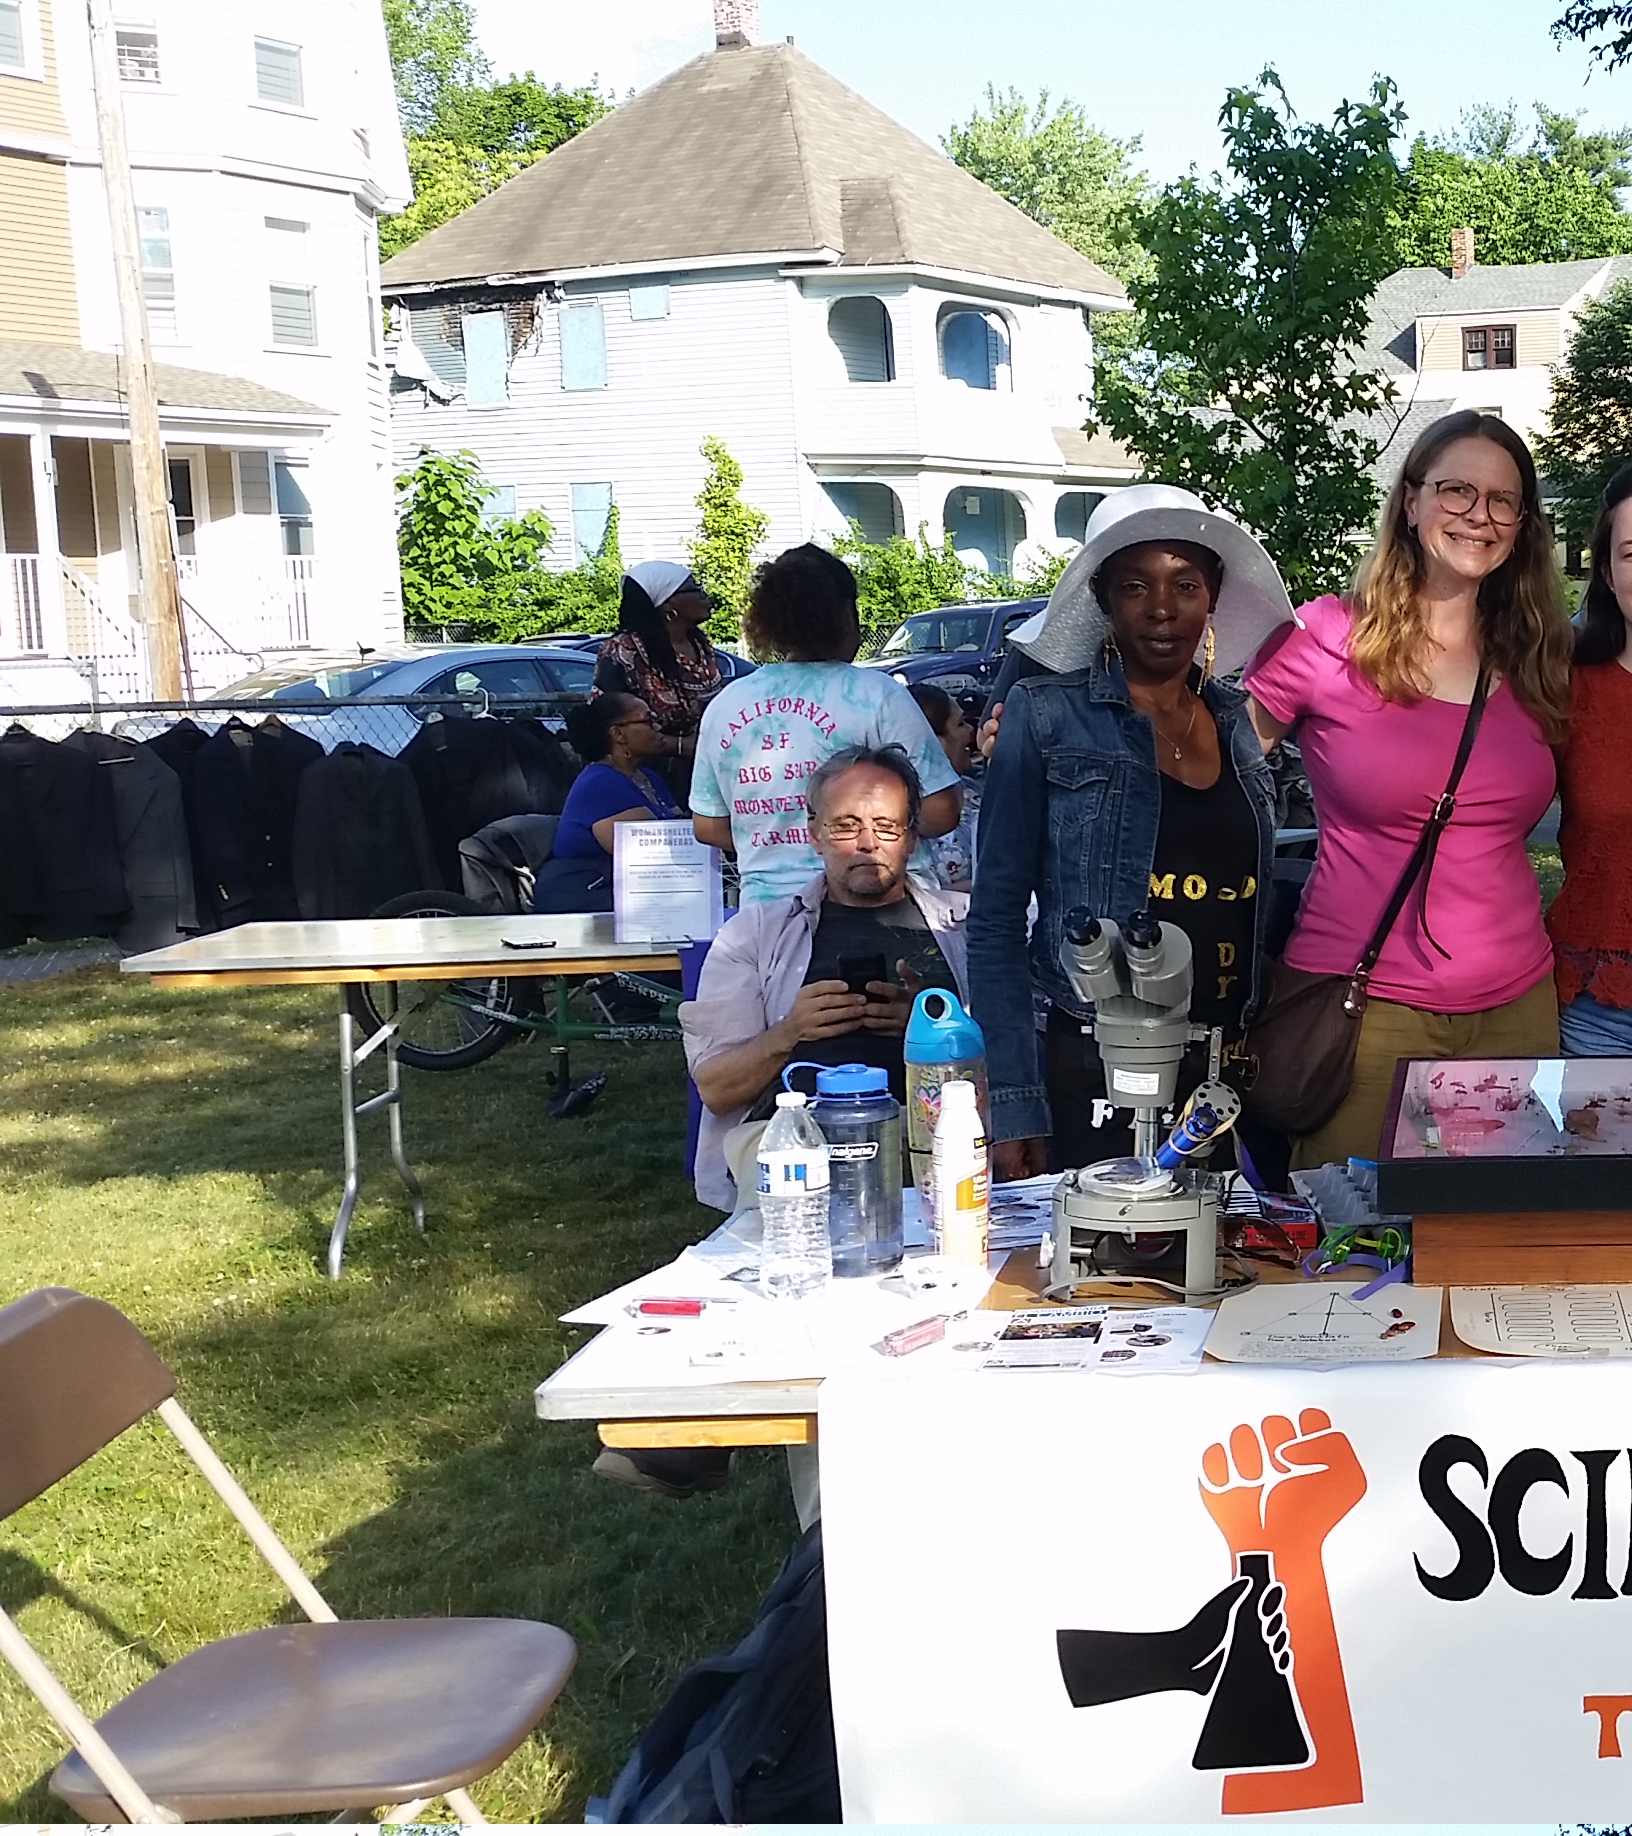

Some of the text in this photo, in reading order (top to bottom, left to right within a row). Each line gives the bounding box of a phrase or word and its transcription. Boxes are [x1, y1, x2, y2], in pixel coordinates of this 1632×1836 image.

[720, 697, 837, 750] CALIFORNIA
[738, 765, 772, 784] BIG
[630, 827, 695, 837] WOMANSHELTE
